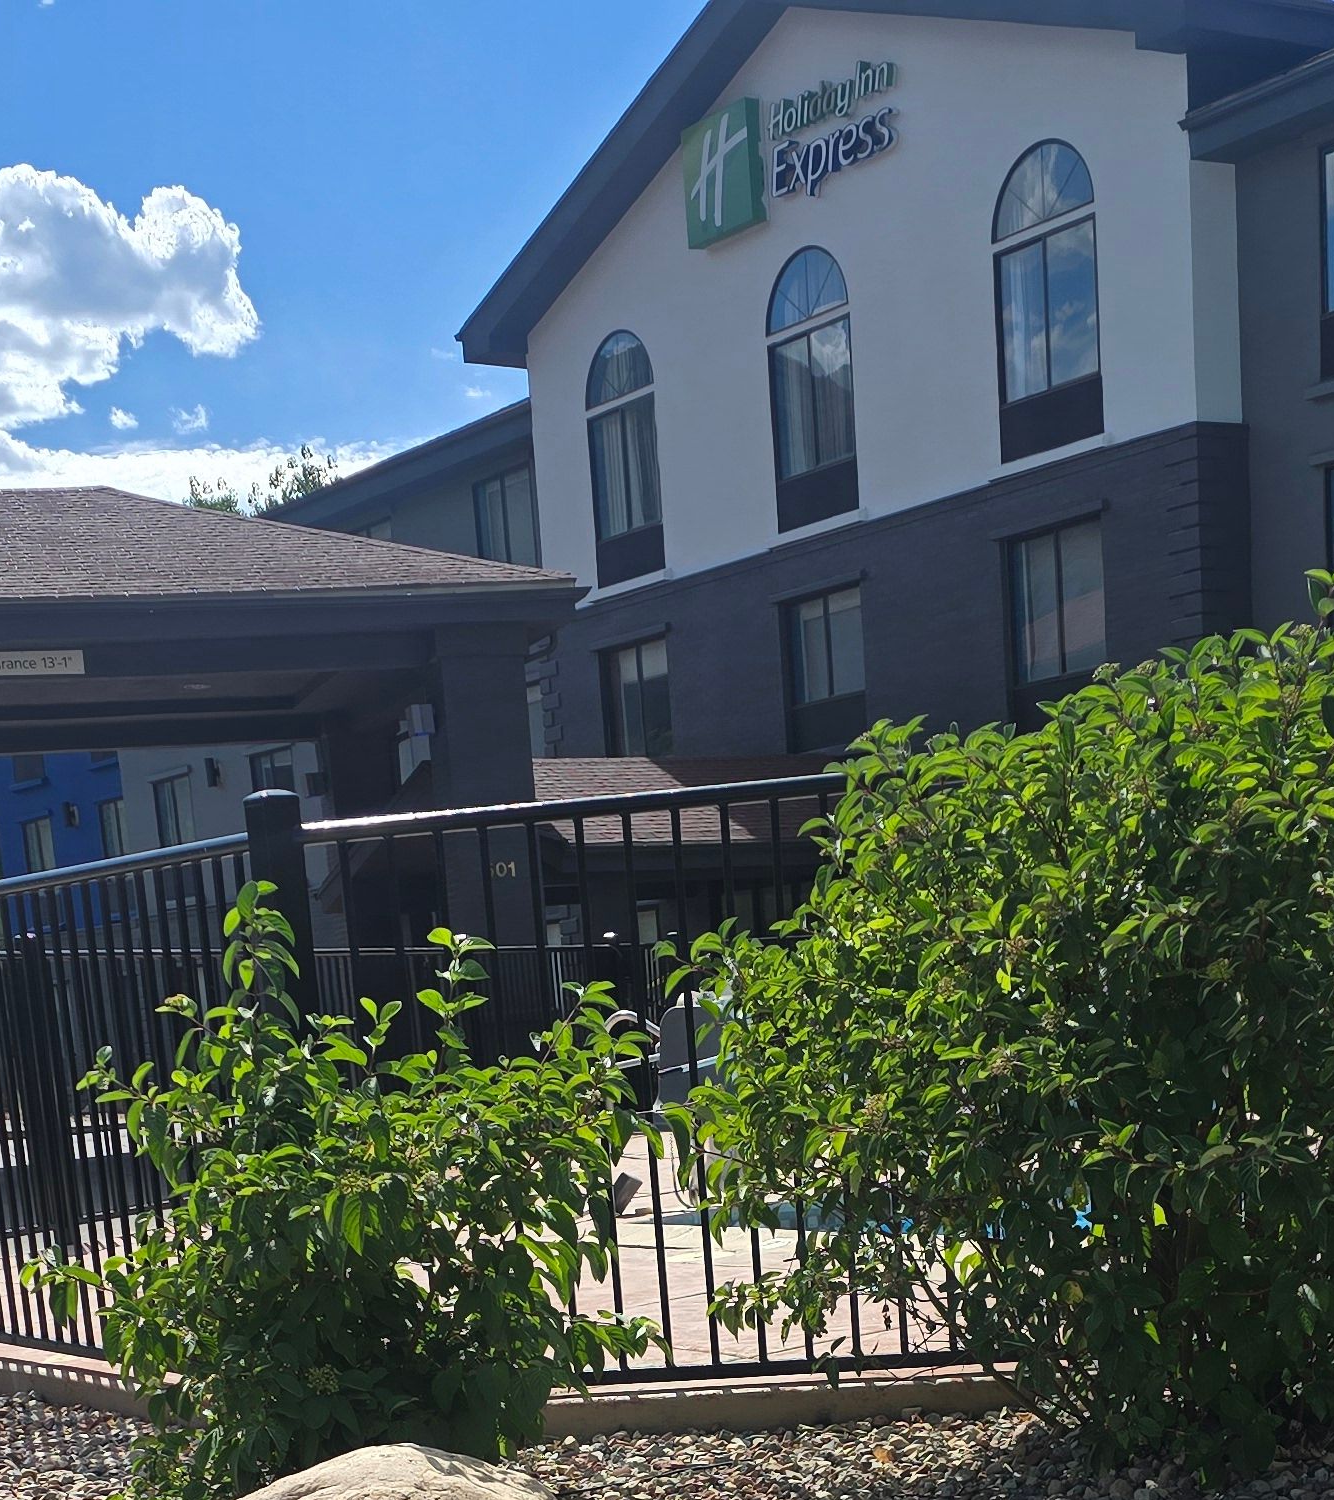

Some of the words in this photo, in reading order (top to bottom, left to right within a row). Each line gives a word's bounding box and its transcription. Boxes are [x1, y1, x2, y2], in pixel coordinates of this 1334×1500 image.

[767, 80, 854, 141] Holiday
[854, 60, 896, 99] Inn
[770, 107, 896, 198] Express
[41, 656, 73, 669] 13'-1"
